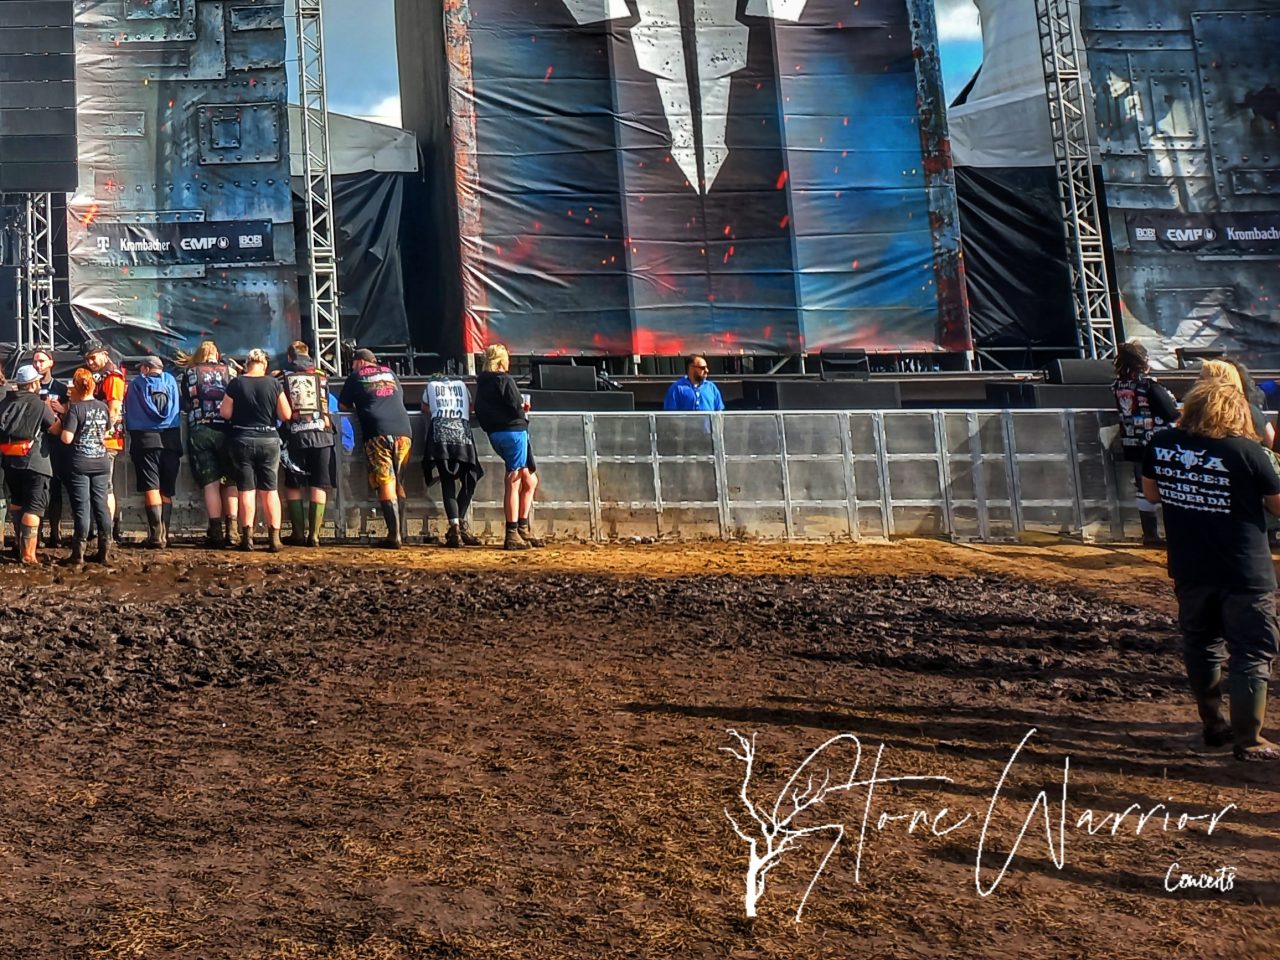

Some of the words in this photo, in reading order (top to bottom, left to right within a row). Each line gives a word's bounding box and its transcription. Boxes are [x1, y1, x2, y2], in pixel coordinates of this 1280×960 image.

[1167, 228, 1203, 241] EMP
[120, 238, 171, 252] Krombacher
[180, 237, 217, 250] EMP
[435, 386, 446, 397] DO
[448, 386, 463, 397] YOU
[436, 398, 454, 408] WANT
[456, 398, 464, 408] TO
[1176, 482, 1199, 493] IST
[1207, 496, 1232, 507] DA!
